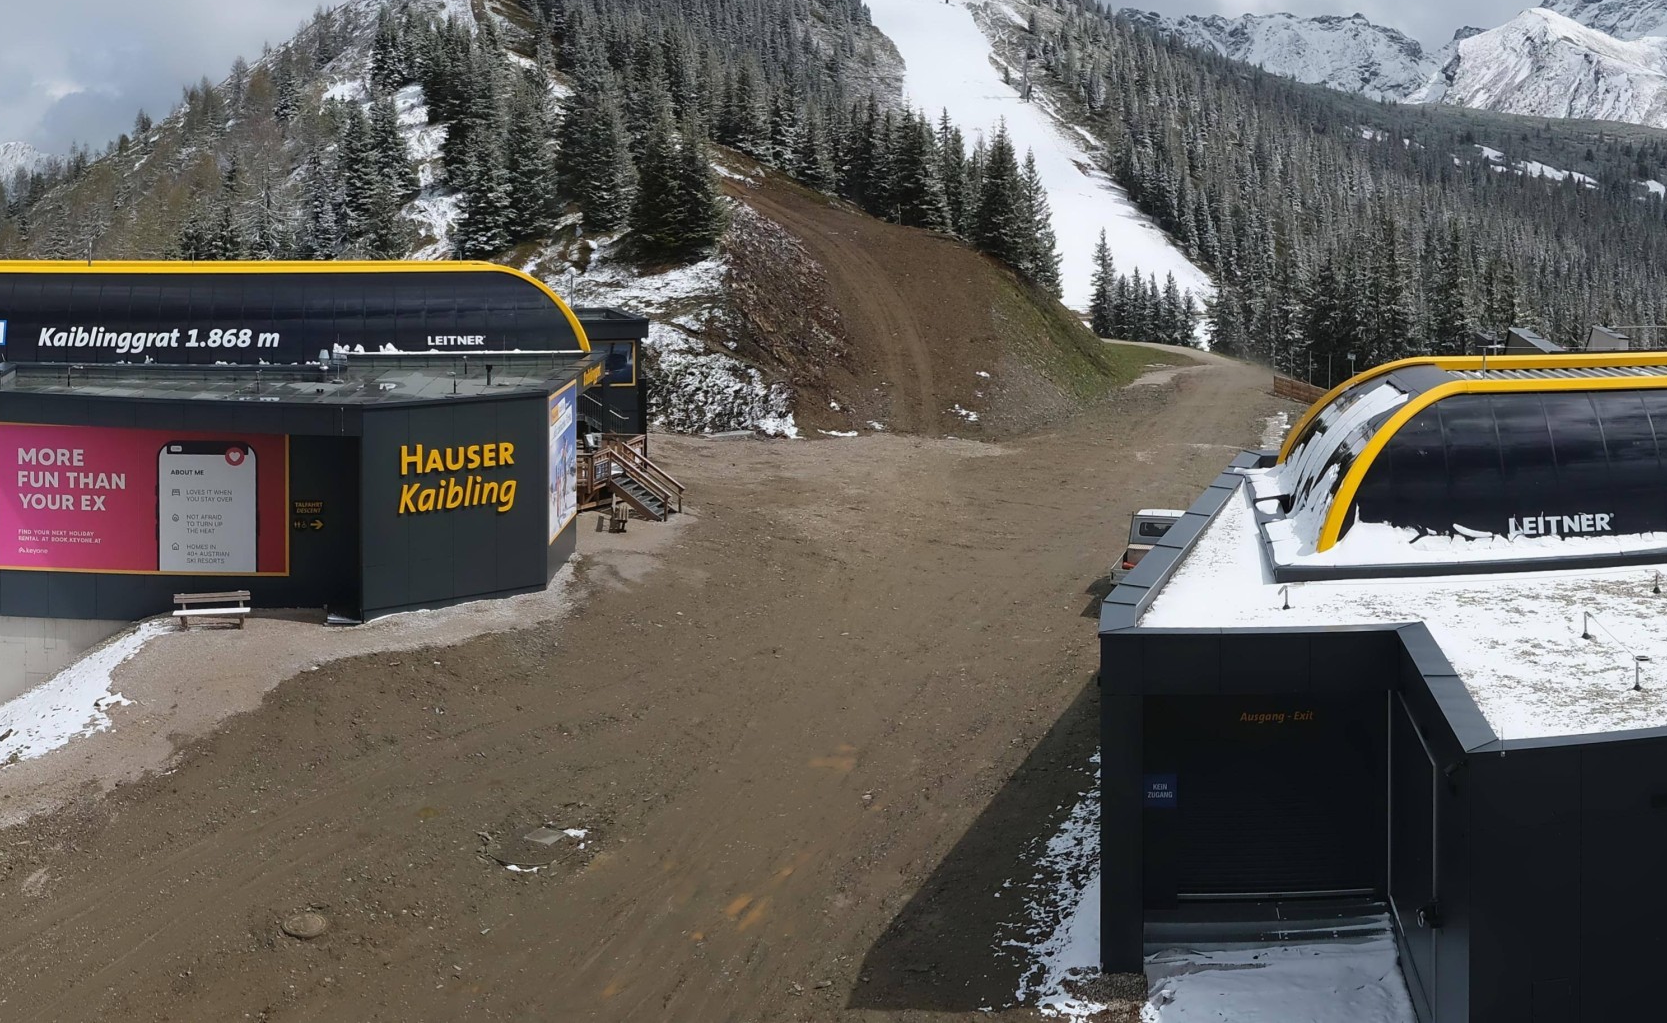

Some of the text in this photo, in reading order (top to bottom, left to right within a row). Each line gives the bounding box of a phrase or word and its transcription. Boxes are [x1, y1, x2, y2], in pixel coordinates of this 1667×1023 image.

[38, 326, 280, 353] Kaiblinggrat 1.868 m
[427, 335, 485, 346] LEITNER
[17, 447, 85, 467] MORE
[401, 442, 515, 475] HAUSER
[17, 470, 126, 489] FUN THAN
[19, 493, 106, 511] YOUR EX
[398, 476, 517, 514] Kaibling
[1508, 513, 1612, 535] LEITNER
[1240, 712, 1285, 723] Ausgang
[1293, 710, 1313, 721] Exit
[1147, 791, 1173, 799] ZUGANG
